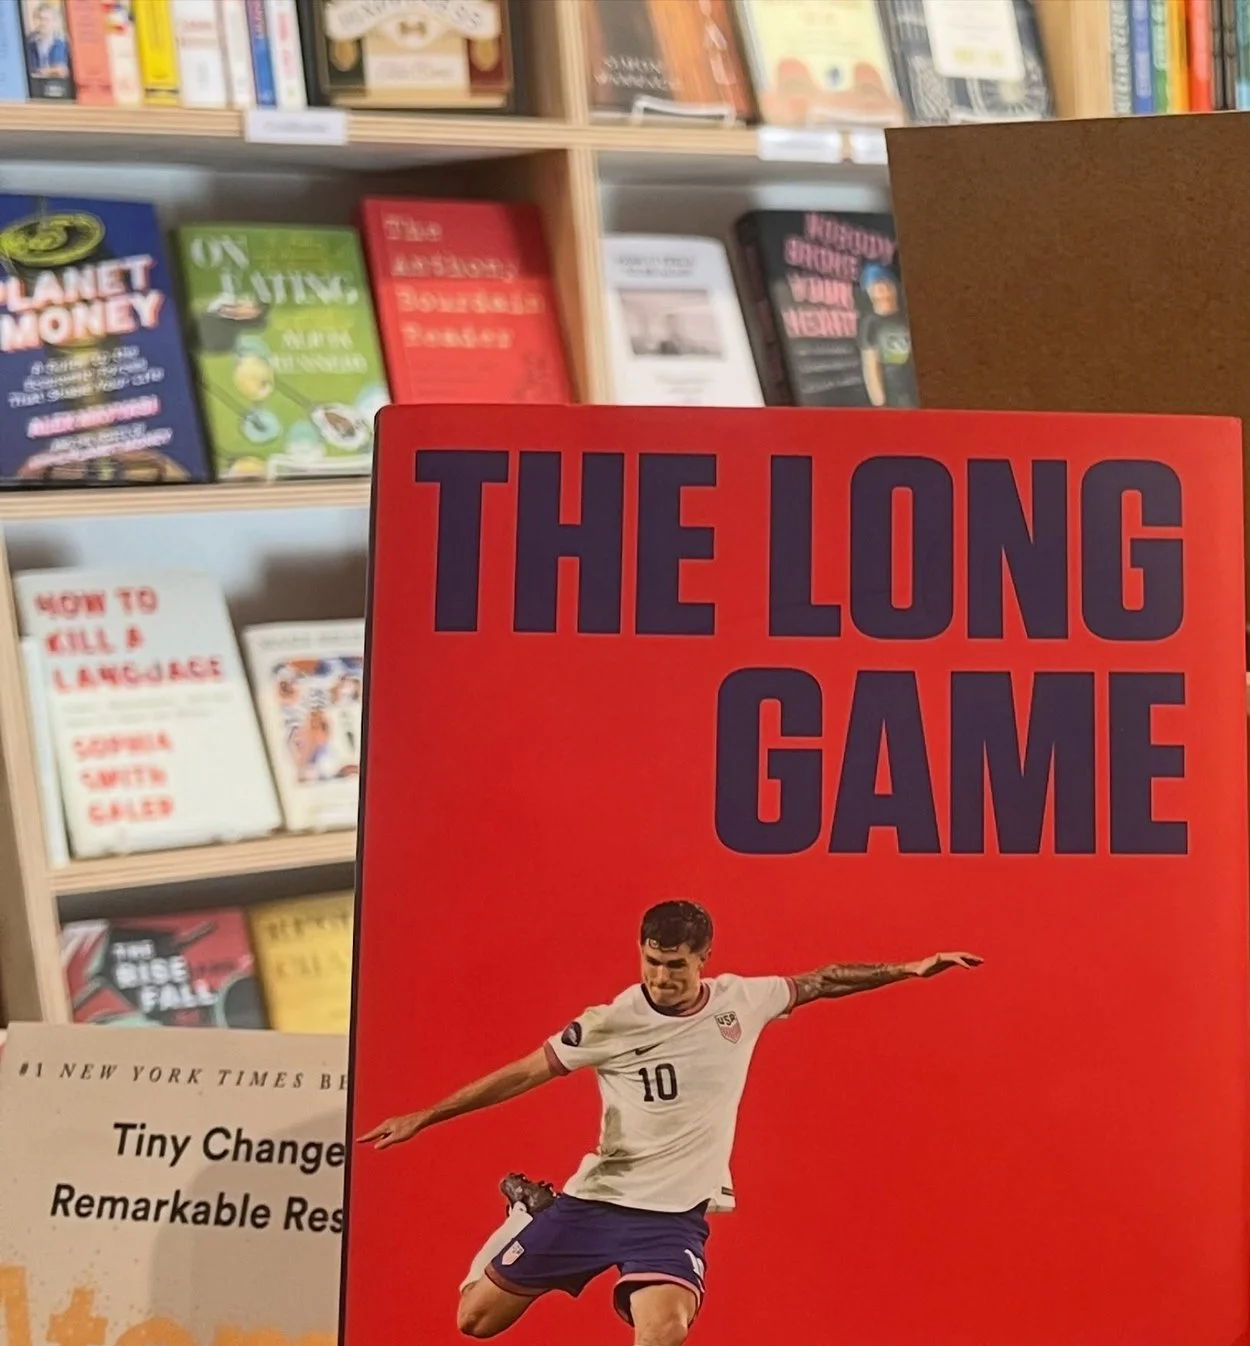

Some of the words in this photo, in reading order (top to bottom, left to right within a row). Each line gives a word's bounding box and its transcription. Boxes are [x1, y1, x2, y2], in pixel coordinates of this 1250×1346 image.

[385, 217, 443, 242] The
[189, 235, 250, 269] ON
[0, 254, 157, 312] LANET
[0, 290, 165, 353] MONEY
[415, 450, 717, 636] THE
[768, 454, 1185, 641] LONG
[35, 587, 107, 618] HOW
[117, 585, 159, 615] TO
[45, 627, 115, 658] KILL
[125, 625, 145, 654] A
[53, 655, 225, 694] LANGUAGE
[714, 667, 1188, 856] GAME
[113, 939, 155, 961] THE
[116, 954, 189, 989] RISE
[139, 979, 219, 1014] FALL
[18, 1061, 44, 1079] #1
[60, 1062, 118, 1081] NEW
[132, 1064, 204, 1085] YORK
[218, 1069, 304, 1090] TIMES
[638, 1062, 678, 1102] 10
[113, 1122, 191, 1167] Tiny
[50, 1183, 271, 1231] Remarkable
